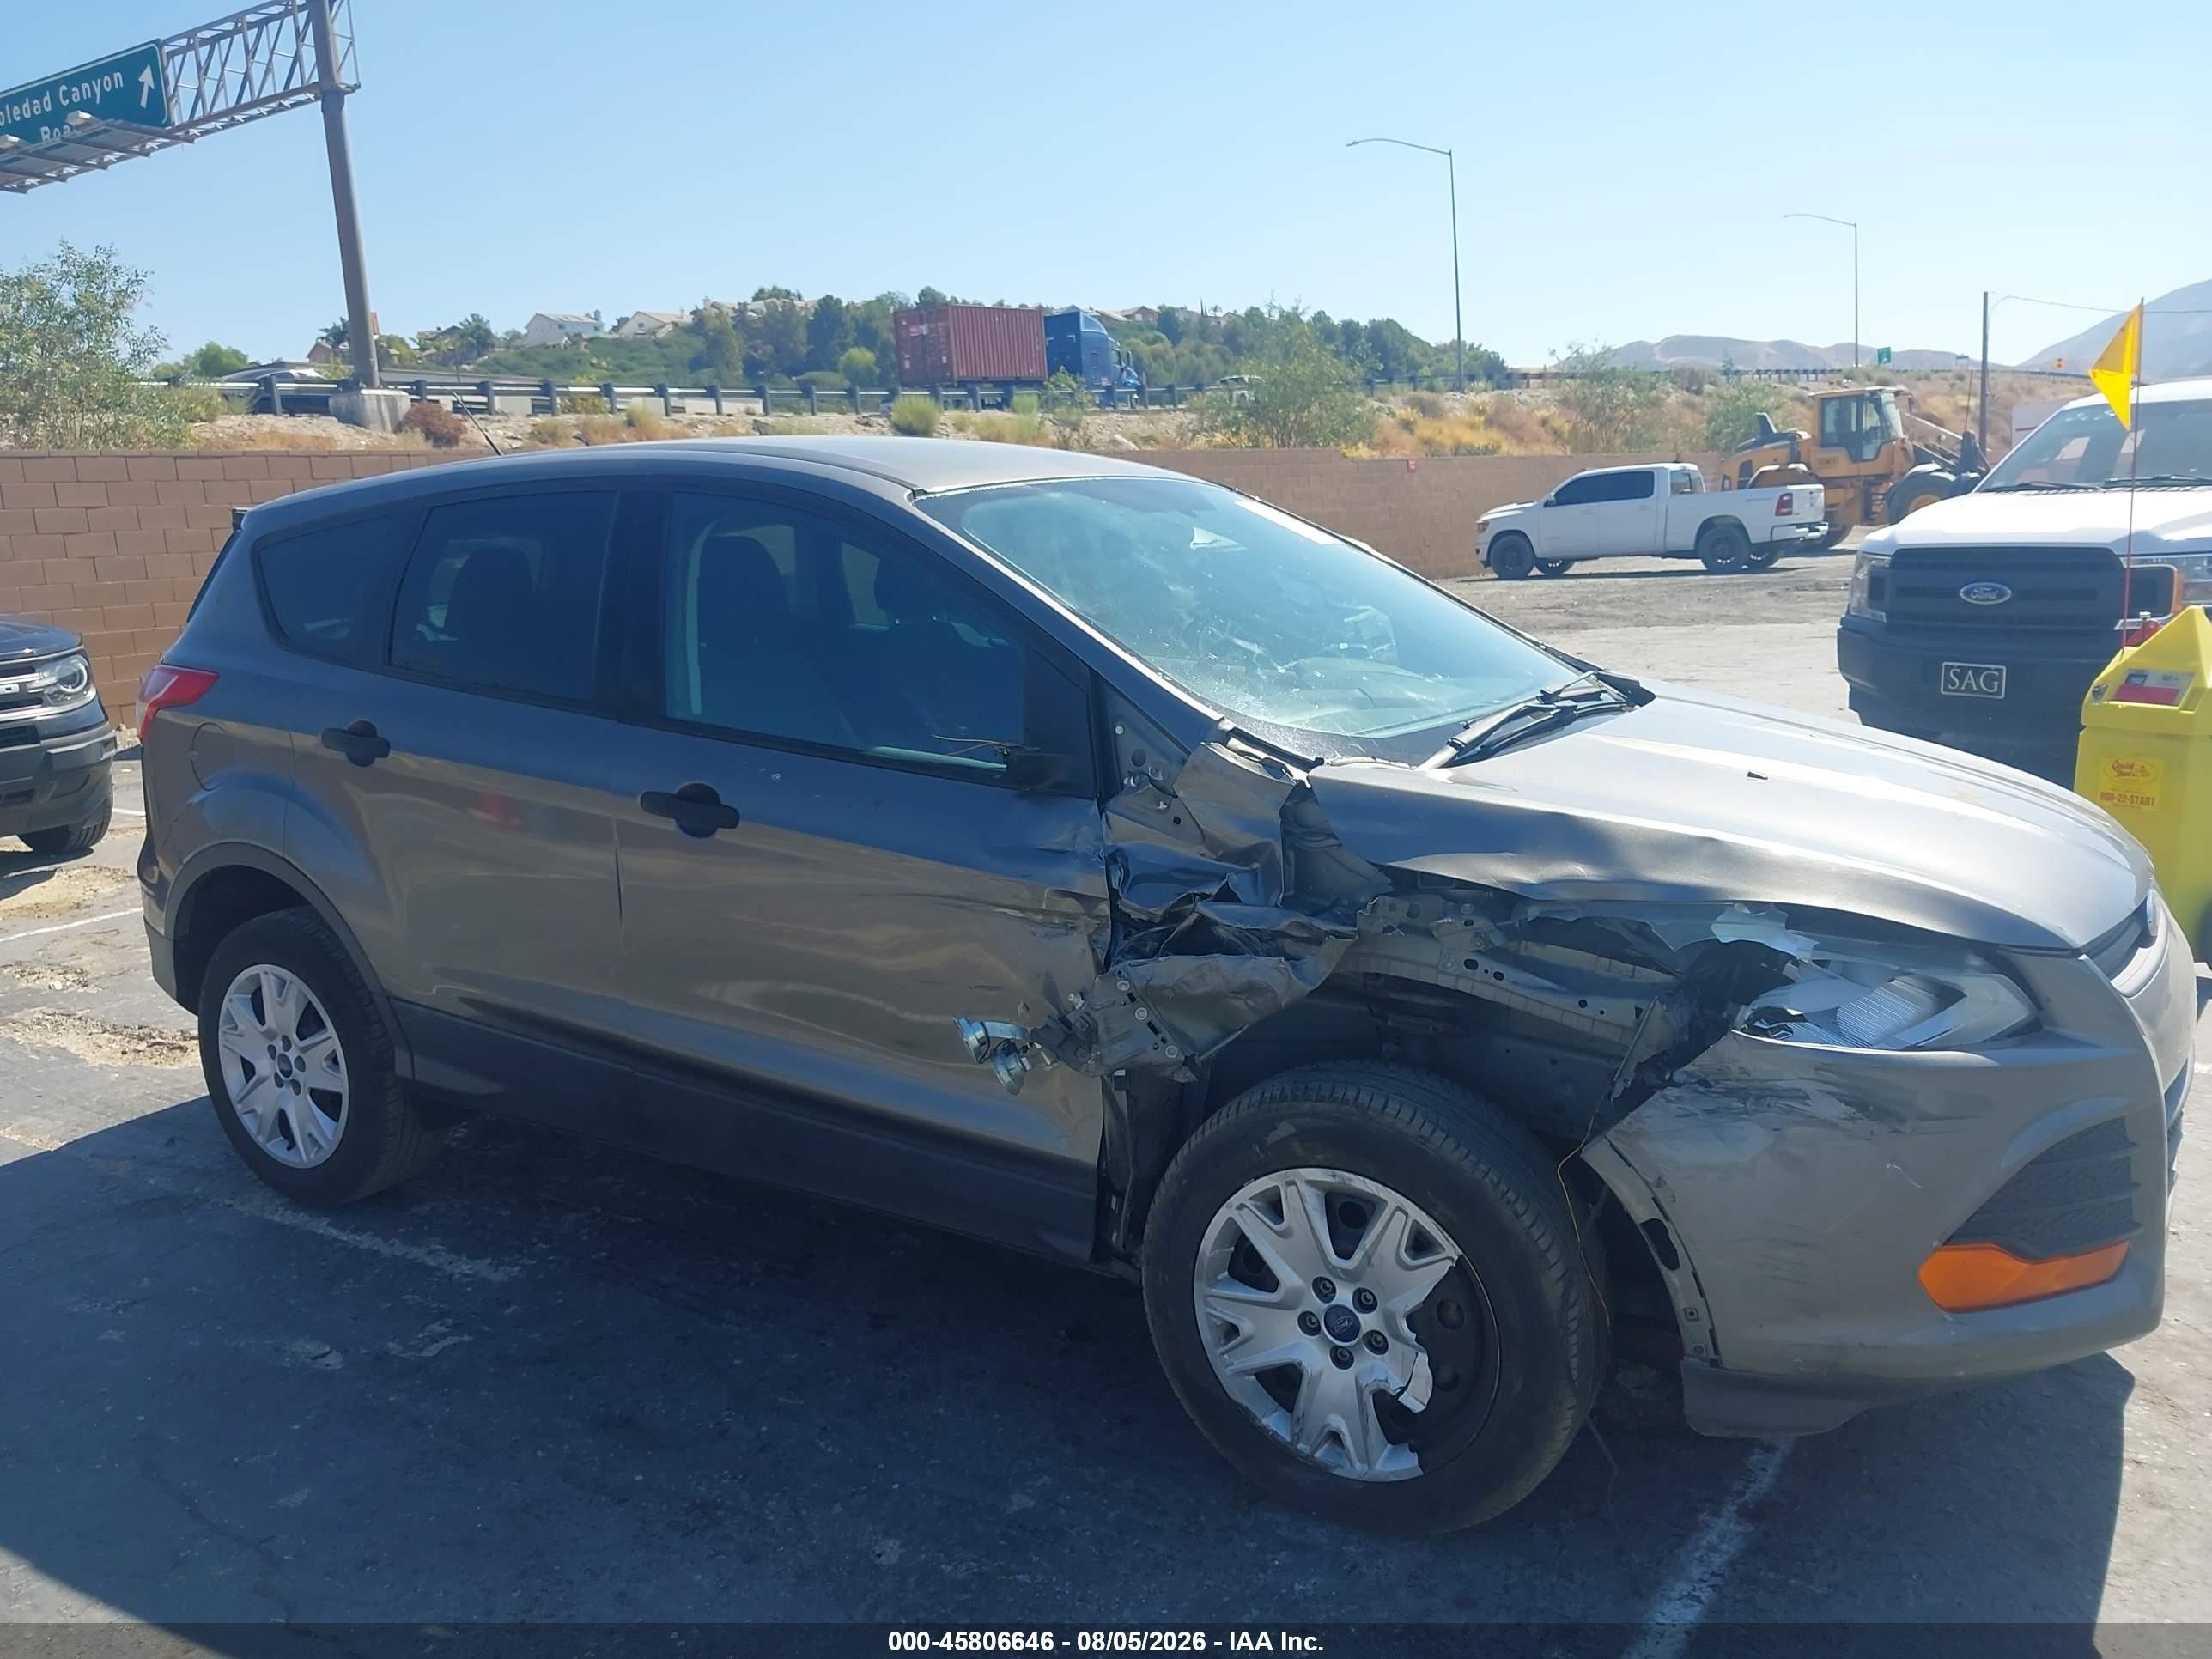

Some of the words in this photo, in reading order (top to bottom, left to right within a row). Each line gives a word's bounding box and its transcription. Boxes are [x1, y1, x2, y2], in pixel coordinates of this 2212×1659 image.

[0, 90, 52, 127] oledad
[59, 70, 124, 106] Canyon
[40, 124, 72, 144] Roa
[1948, 668, 2000, 693] SAG
